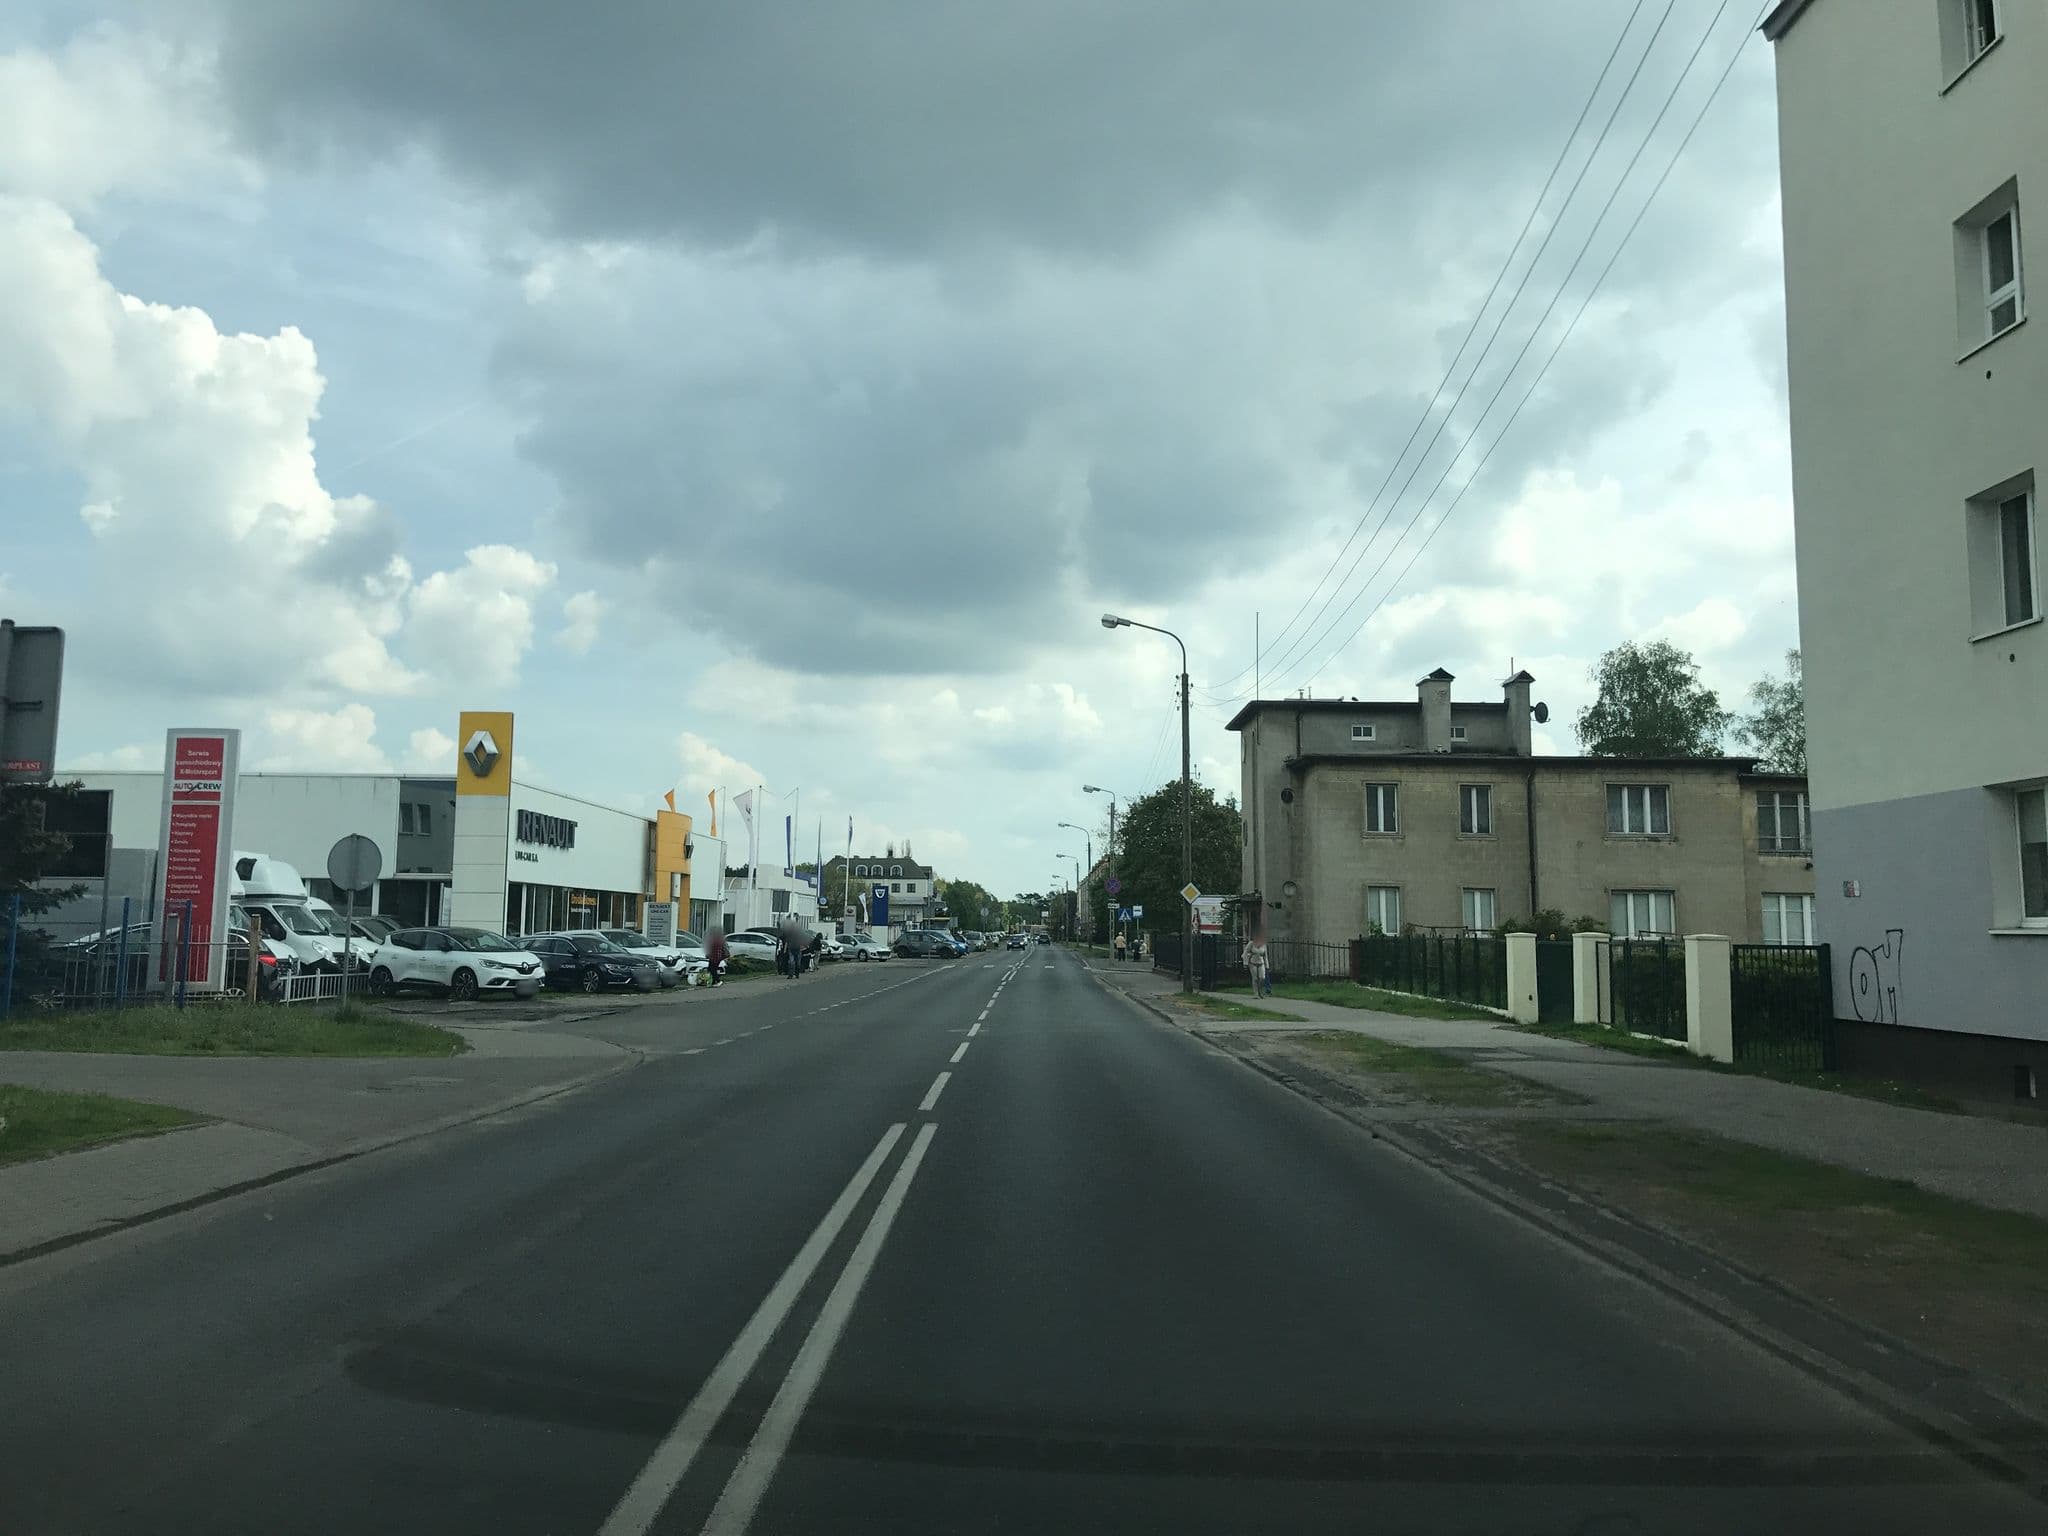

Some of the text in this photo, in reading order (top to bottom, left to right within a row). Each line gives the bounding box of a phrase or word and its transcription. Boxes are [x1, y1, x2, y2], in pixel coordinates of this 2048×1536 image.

[173, 782, 221, 790] AUTO CREW
[517, 809, 578, 849] RENAULT
